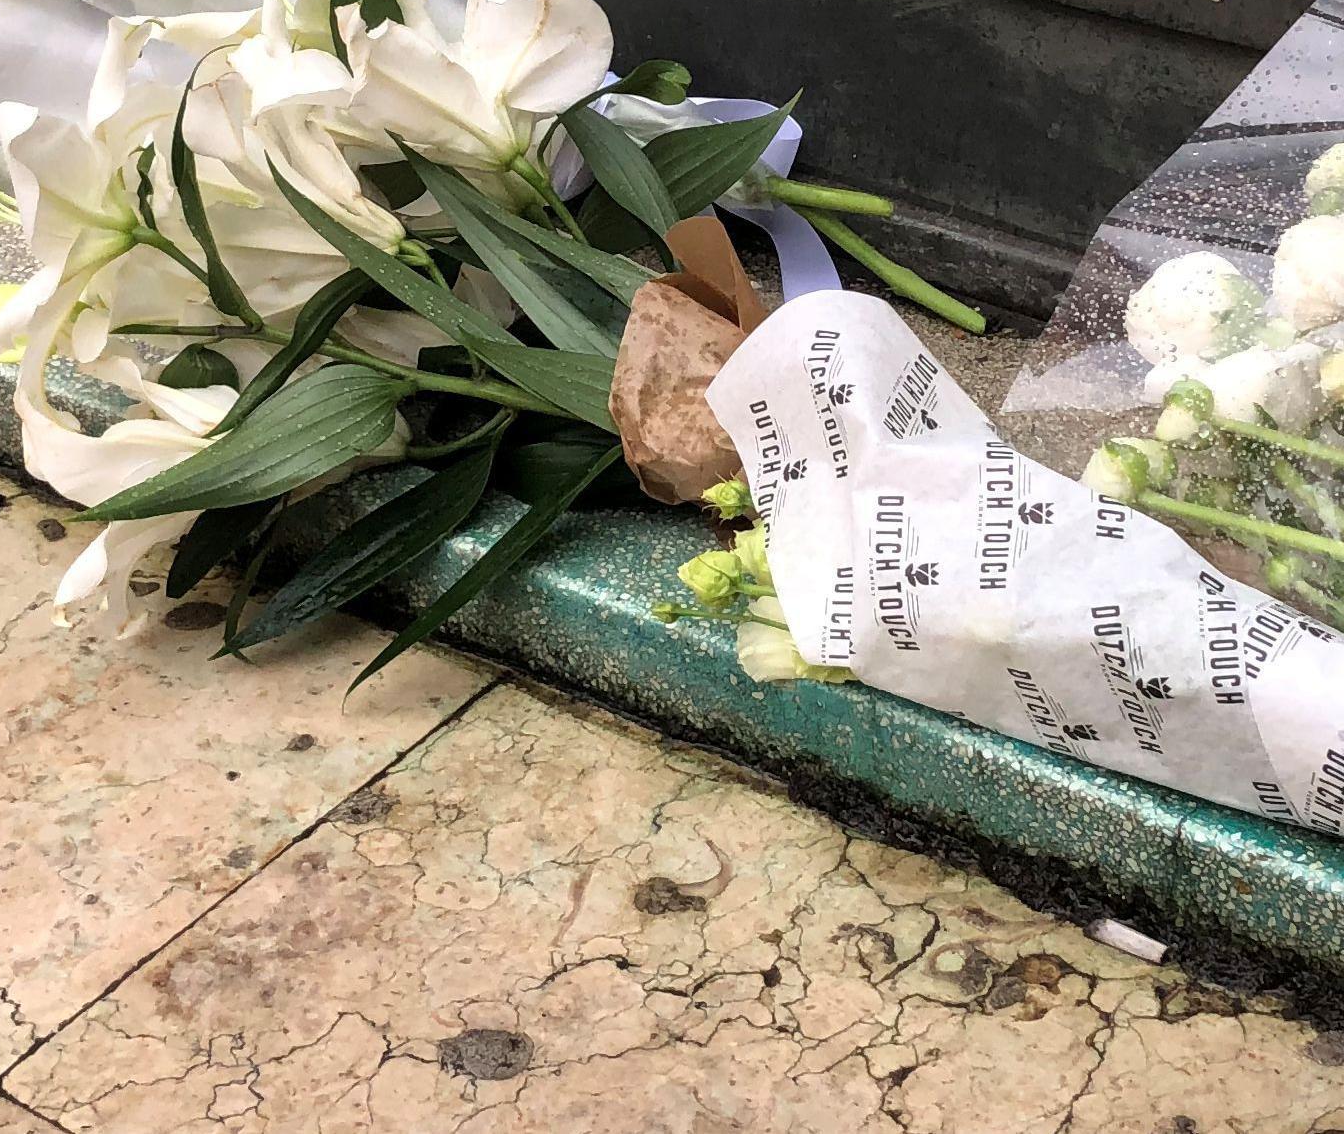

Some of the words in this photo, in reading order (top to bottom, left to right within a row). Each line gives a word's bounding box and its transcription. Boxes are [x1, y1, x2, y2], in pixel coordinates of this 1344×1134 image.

[807, 330, 840, 396] DUTCH
[902, 353, 938, 404] DUTCH
[749, 399, 781, 474] DUTCH
[820, 403, 849, 479] TOUCH
[883, 392, 916, 440] TOUCH
[985, 441, 1014, 508] DUTCH
[875, 495, 905, 571] DUTCH
[1095, 493, 1126, 539] UCH
[979, 519, 1013, 589] TOUCH
[877, 581, 920, 651] TOUCH
[1006, 667, 1058, 728] DUTCH
[1091, 605, 1132, 683] DUTCH
[1117, 687, 1163, 755] TOUCH
[1208, 623, 1244, 704] TOUCH
